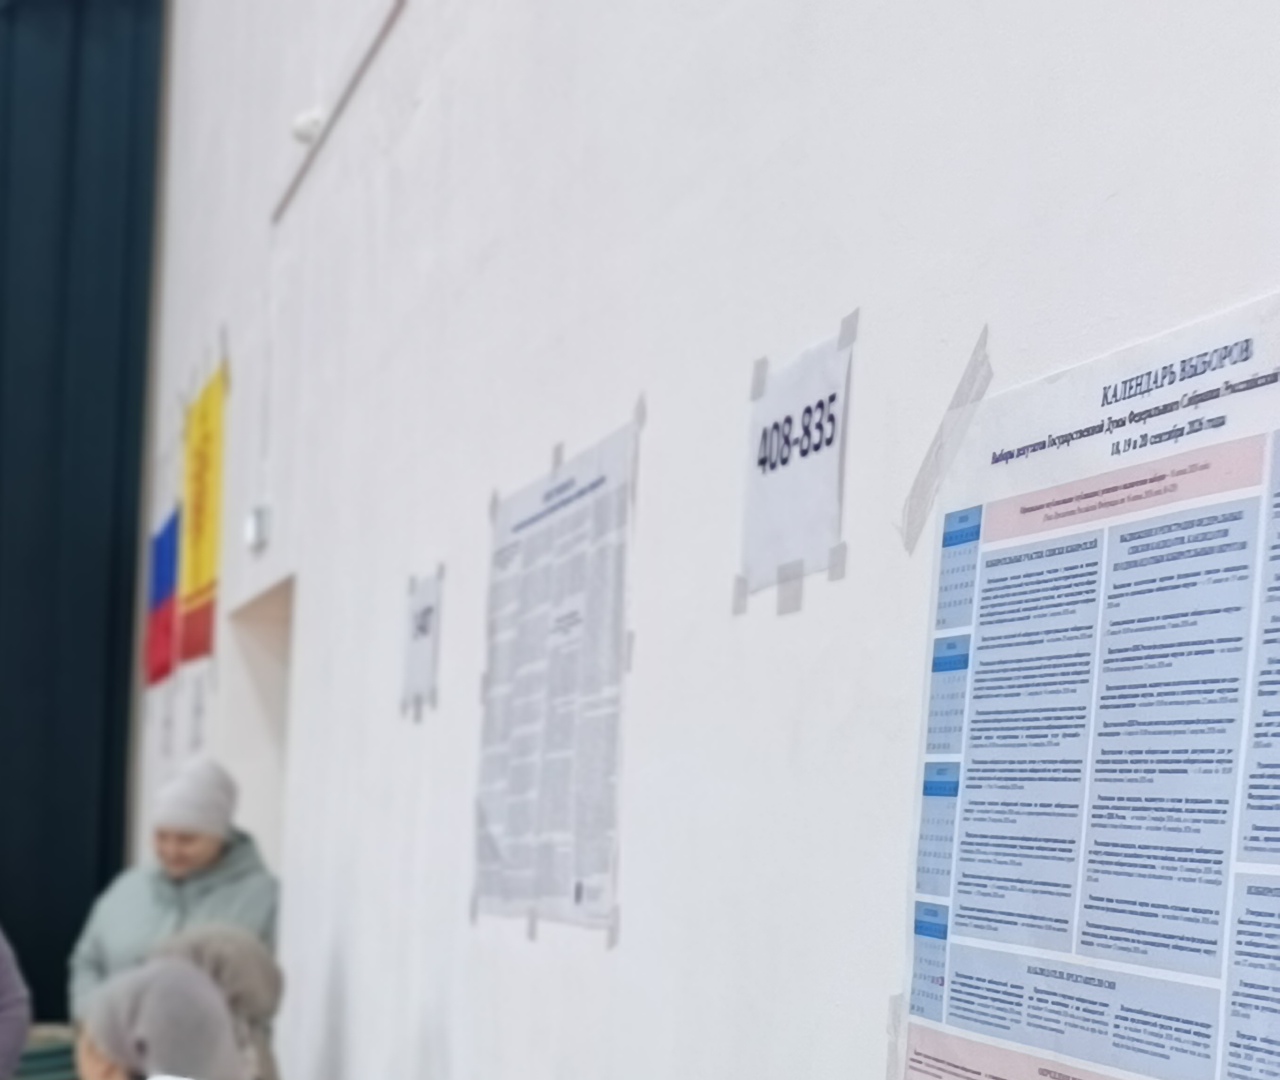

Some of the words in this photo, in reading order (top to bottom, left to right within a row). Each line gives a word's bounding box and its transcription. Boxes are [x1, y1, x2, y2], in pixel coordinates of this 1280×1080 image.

[1101, 363, 1176, 407] КАЛЕНДАРЬ
[1179, 338, 1254, 382] ВЫБОРОВ
[757, 392, 837, 474] 408-835
